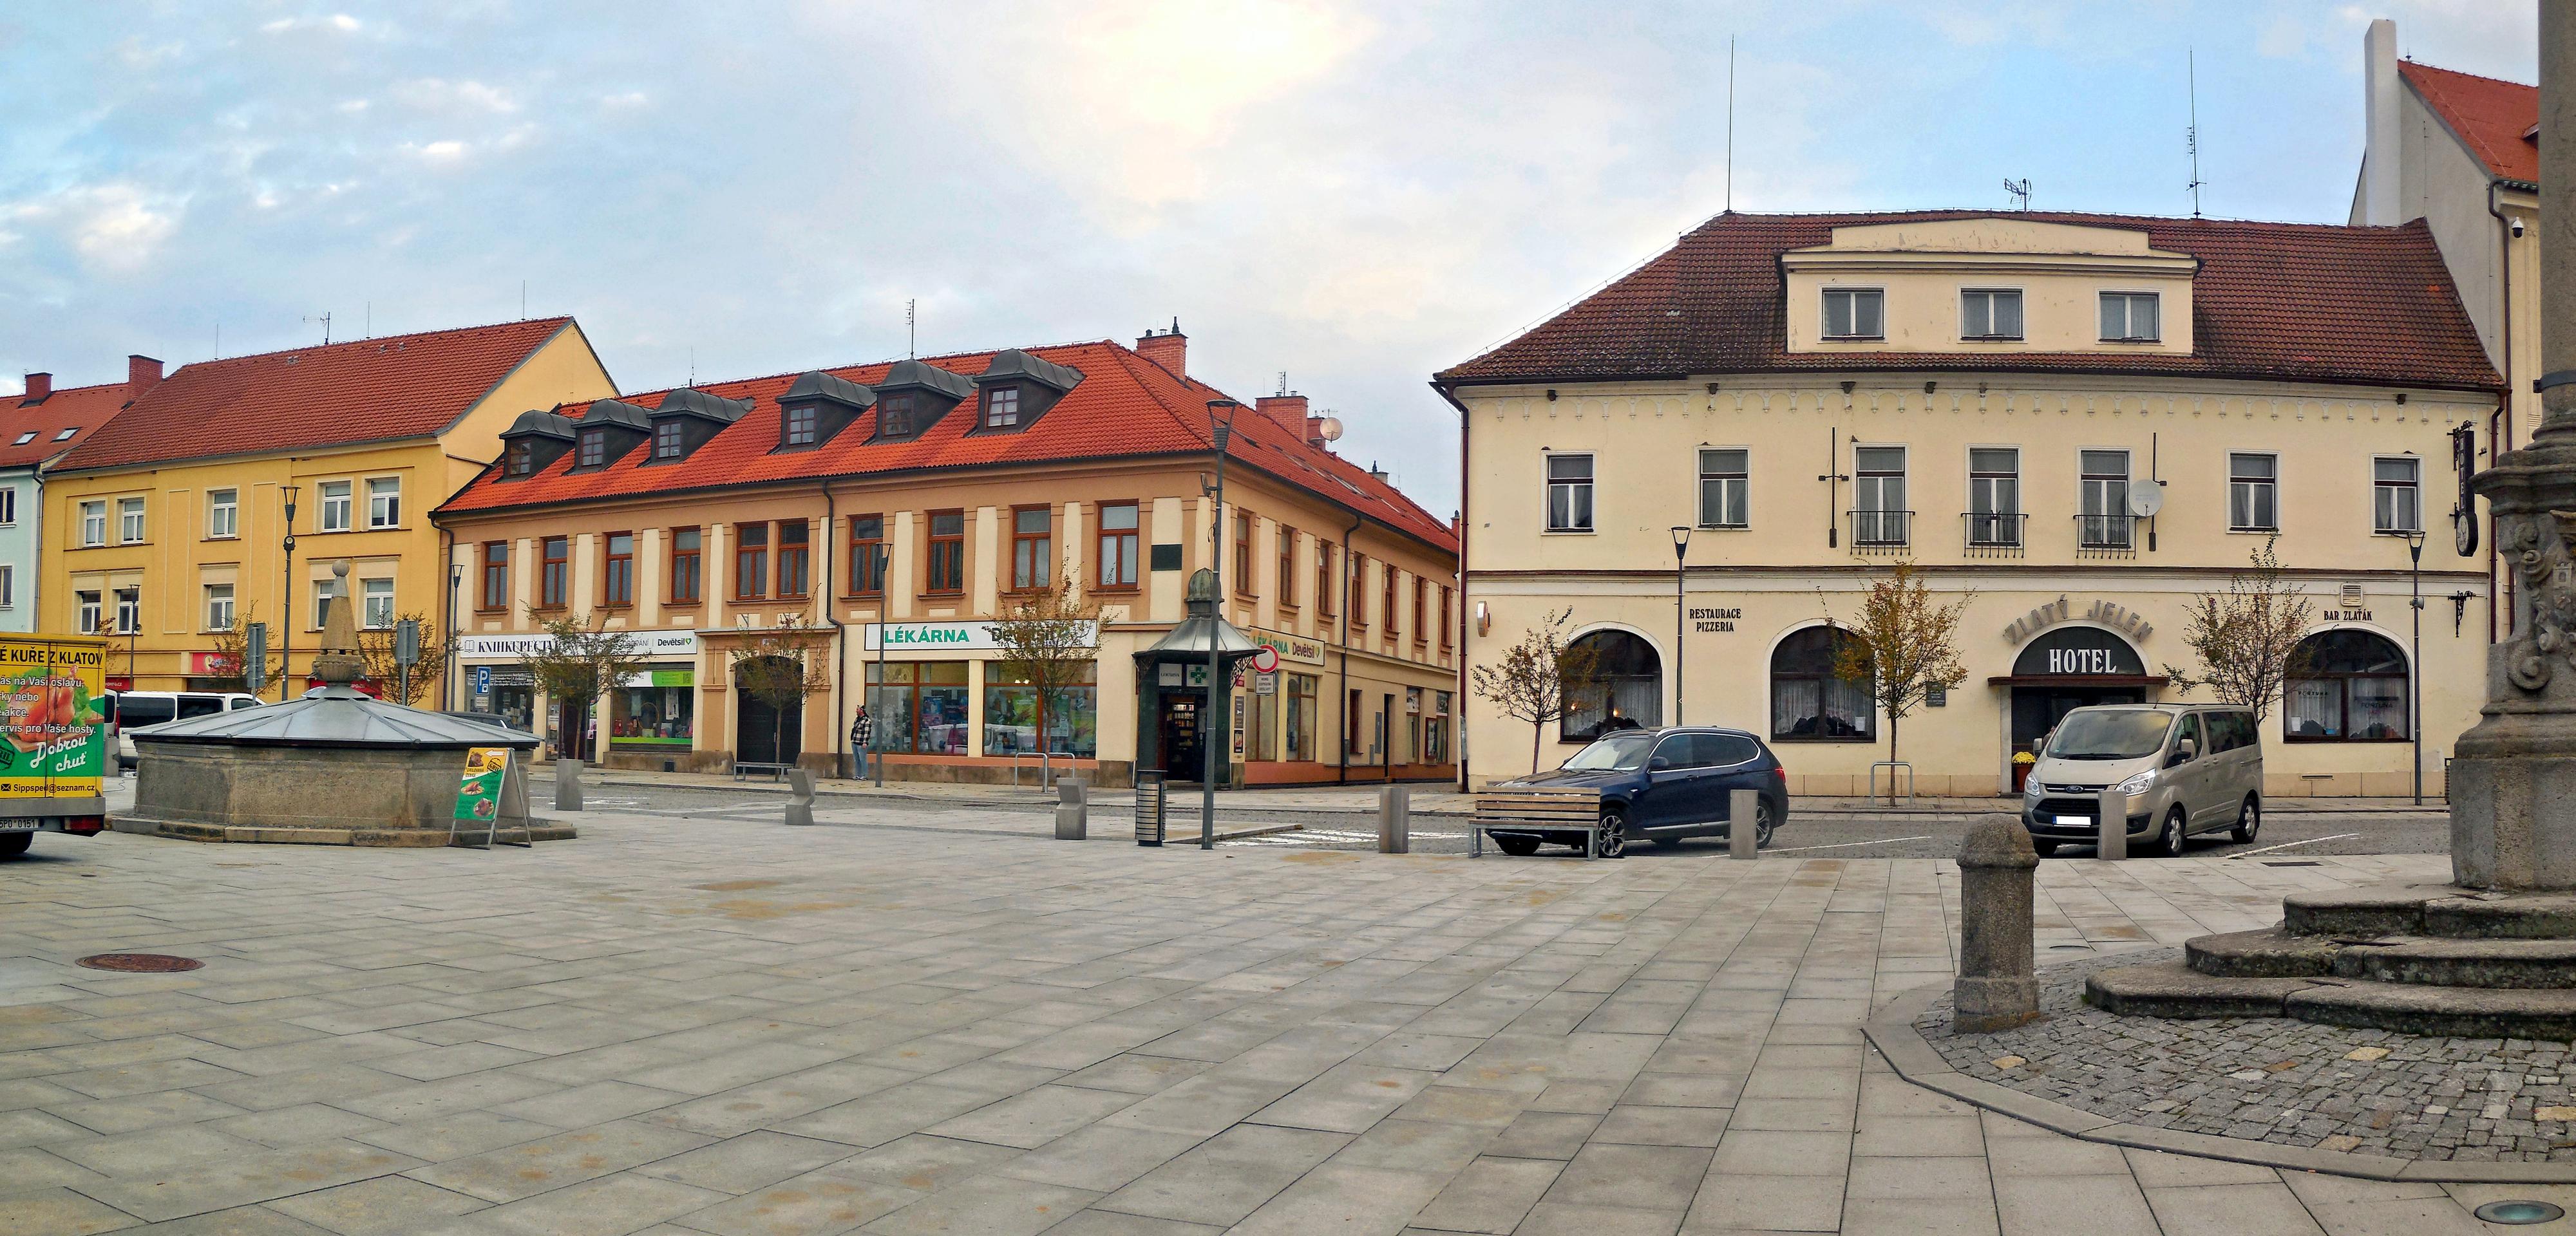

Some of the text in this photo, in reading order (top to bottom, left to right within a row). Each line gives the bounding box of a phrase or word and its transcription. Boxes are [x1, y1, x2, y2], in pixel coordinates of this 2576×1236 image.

[1689, 608, 1741, 619] RESTAURACE
[2003, 594, 2154, 644] ZLATÝ JELEN
[2324, 609, 2372, 621] BAR ZLAŤÁK
[1696, 621, 1734, 632] PIZZERIA
[884, 626, 969, 643] LÉKÁRNA
[658, 638, 685, 646] Devětsil
[11, 646, 45, 662] KUŘE
[50, 651, 55, 664] Z
[59, 651, 103, 665] KLATOV
[1292, 642, 1315, 659] Devětsil
[2049, 649, 2117, 673] HOTEL
[29, 677, 48, 686] Vaši
[51, 678, 84, 688] oslavu,
[479, 670, 488, 686] P
[15, 693, 39, 702] nebo
[5, 707, 29, 716] akce.
[26, 726, 41, 735] pro
[44, 724, 66, 733] Vaše
[69, 725, 96, 735] hosty.
[30, 736, 88, 768] Dobrou
[56, 751, 87, 772] chuť
[14, 783, 95, 793] Sippsped@seznam.cz
[18, 819, 35, 828] 0151
